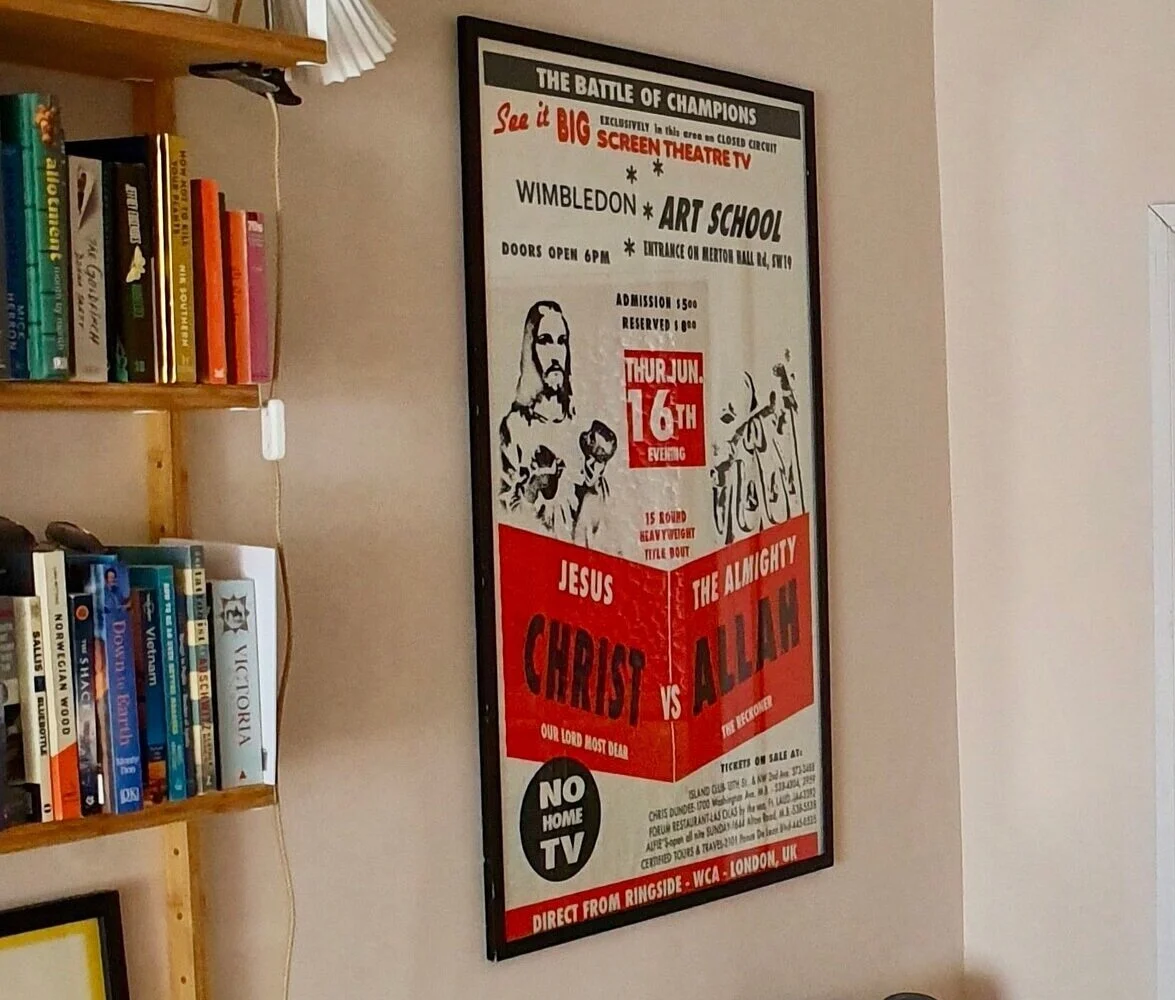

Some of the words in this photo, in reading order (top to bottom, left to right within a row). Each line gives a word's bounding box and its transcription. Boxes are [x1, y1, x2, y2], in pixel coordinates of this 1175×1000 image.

[536, 67, 570, 93] THE
[574, 74, 634, 104] BATTLE
[640, 87, 661, 109] OF
[667, 92, 757, 126] CHAMPIONS
[493, 102, 529, 135] See
[536, 100, 550, 127] it
[556, 107, 590, 145] BIG
[599, 115, 649, 132] EXCLUSIVELY
[654, 123, 662, 135] in
[665, 124, 680, 138] this
[683, 130, 702, 141] area
[717, 133, 745, 148] CLOSED
[748, 138, 777, 154] CIRCUIT
[179, 150, 187, 177] HOW
[597, 129, 660, 156] SCREEN
[663, 139, 731, 167] THEATRE
[732, 151, 751, 170] TV
[45, 157, 62, 261] allotment
[516, 179, 636, 216] WIMBLEDON
[658, 195, 704, 233] ART
[707, 202, 782, 242] SCHOOL
[502, 241, 542, 258] DOORS
[548, 246, 577, 261] OPEN
[584, 249, 610, 264] 6PM
[643, 240, 685, 259] ENTRANCE
[687, 245, 699, 261] ON
[702, 246, 734, 264] MERTON
[736, 249, 755, 266] HALL
[772, 253, 792, 270] SW19
[54, 266, 63, 293] month
[179, 287, 189, 347] SOUTHERN
[616, 292, 671, 309] ADMISSION
[7, 292, 17, 351] HERRON
[17, 305, 26, 340] MICK
[622, 316, 671, 331] RESERVED
[648, 447, 686, 462] EVENING
[639, 527, 696, 542] HEAVYWEIGHT
[645, 511, 656, 526] 15
[659, 510, 687, 524] ROUND
[644, 548, 666, 561] TITLE
[669, 546, 690, 559] BOUT
[692, 566, 719, 611] THE
[723, 534, 797, 597] ALMIGHTY
[558, 559, 614, 606] JESUS
[32, 631, 43, 672] SALLIS
[54, 613, 68, 691] NORWEGIAN
[112, 620, 127, 672] Down
[146, 626, 157, 686] Vietnam
[692, 578, 800, 717] ALLAH
[523, 613, 646, 727] CHRIST
[198, 660, 211, 735] AUSCHWITZ
[234, 643, 252, 747] VICTORIA
[660, 684, 682, 721] VS
[37, 697, 47, 756] BLUEBOTTLE
[60, 696, 70, 735] WOOD
[117, 694, 133, 746] Earth
[721, 719, 736, 739] THE
[540, 723, 559, 743] OUR
[560, 727, 582, 749] LORD
[584, 733, 606, 755] MOST
[607, 740, 629, 761] DEAR
[720, 758, 751, 773] TICKETS
[754, 755, 766, 766] ON
[768, 750, 788, 763] SALE
[539, 775, 586, 810] NO
[542, 808, 583, 832] HOME
[648, 807, 668, 822] CHRIS
[648, 823, 671, 838] FORUM
[539, 831, 586, 871] TV
[640, 852, 672, 870] CERTIFIED
[673, 846, 694, 861] TOURS
[532, 903, 578, 934] DIRECT
[582, 892, 621, 920] FROM
[624, 875, 682, 908] RINGSIDE
[692, 865, 720, 888] WCA
[782, 843, 798, 862] UK
